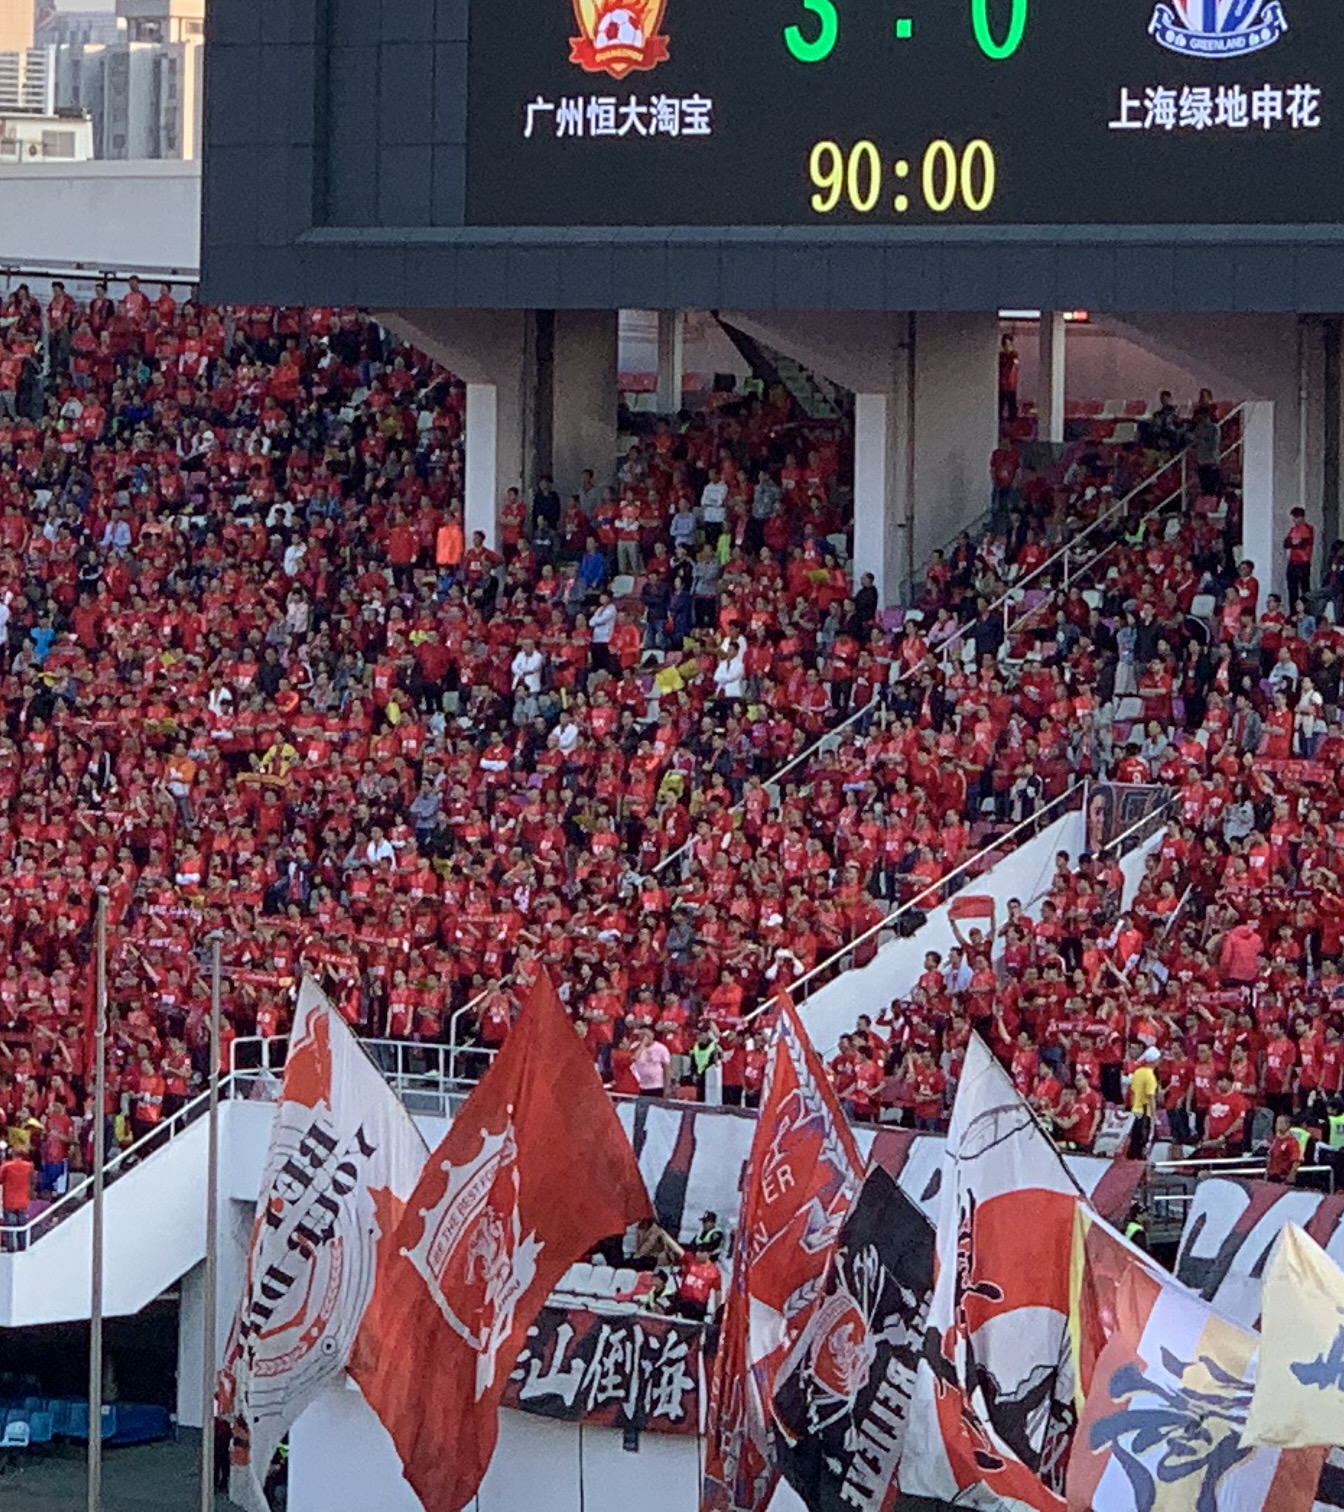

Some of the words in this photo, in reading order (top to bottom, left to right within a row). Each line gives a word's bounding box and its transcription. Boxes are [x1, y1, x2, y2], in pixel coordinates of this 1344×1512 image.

[523, 93, 714, 139] 广州恒大淘宝
[1108, 85, 1322, 131] 上海绿地申花
[808, 139, 997, 214] 90:00
